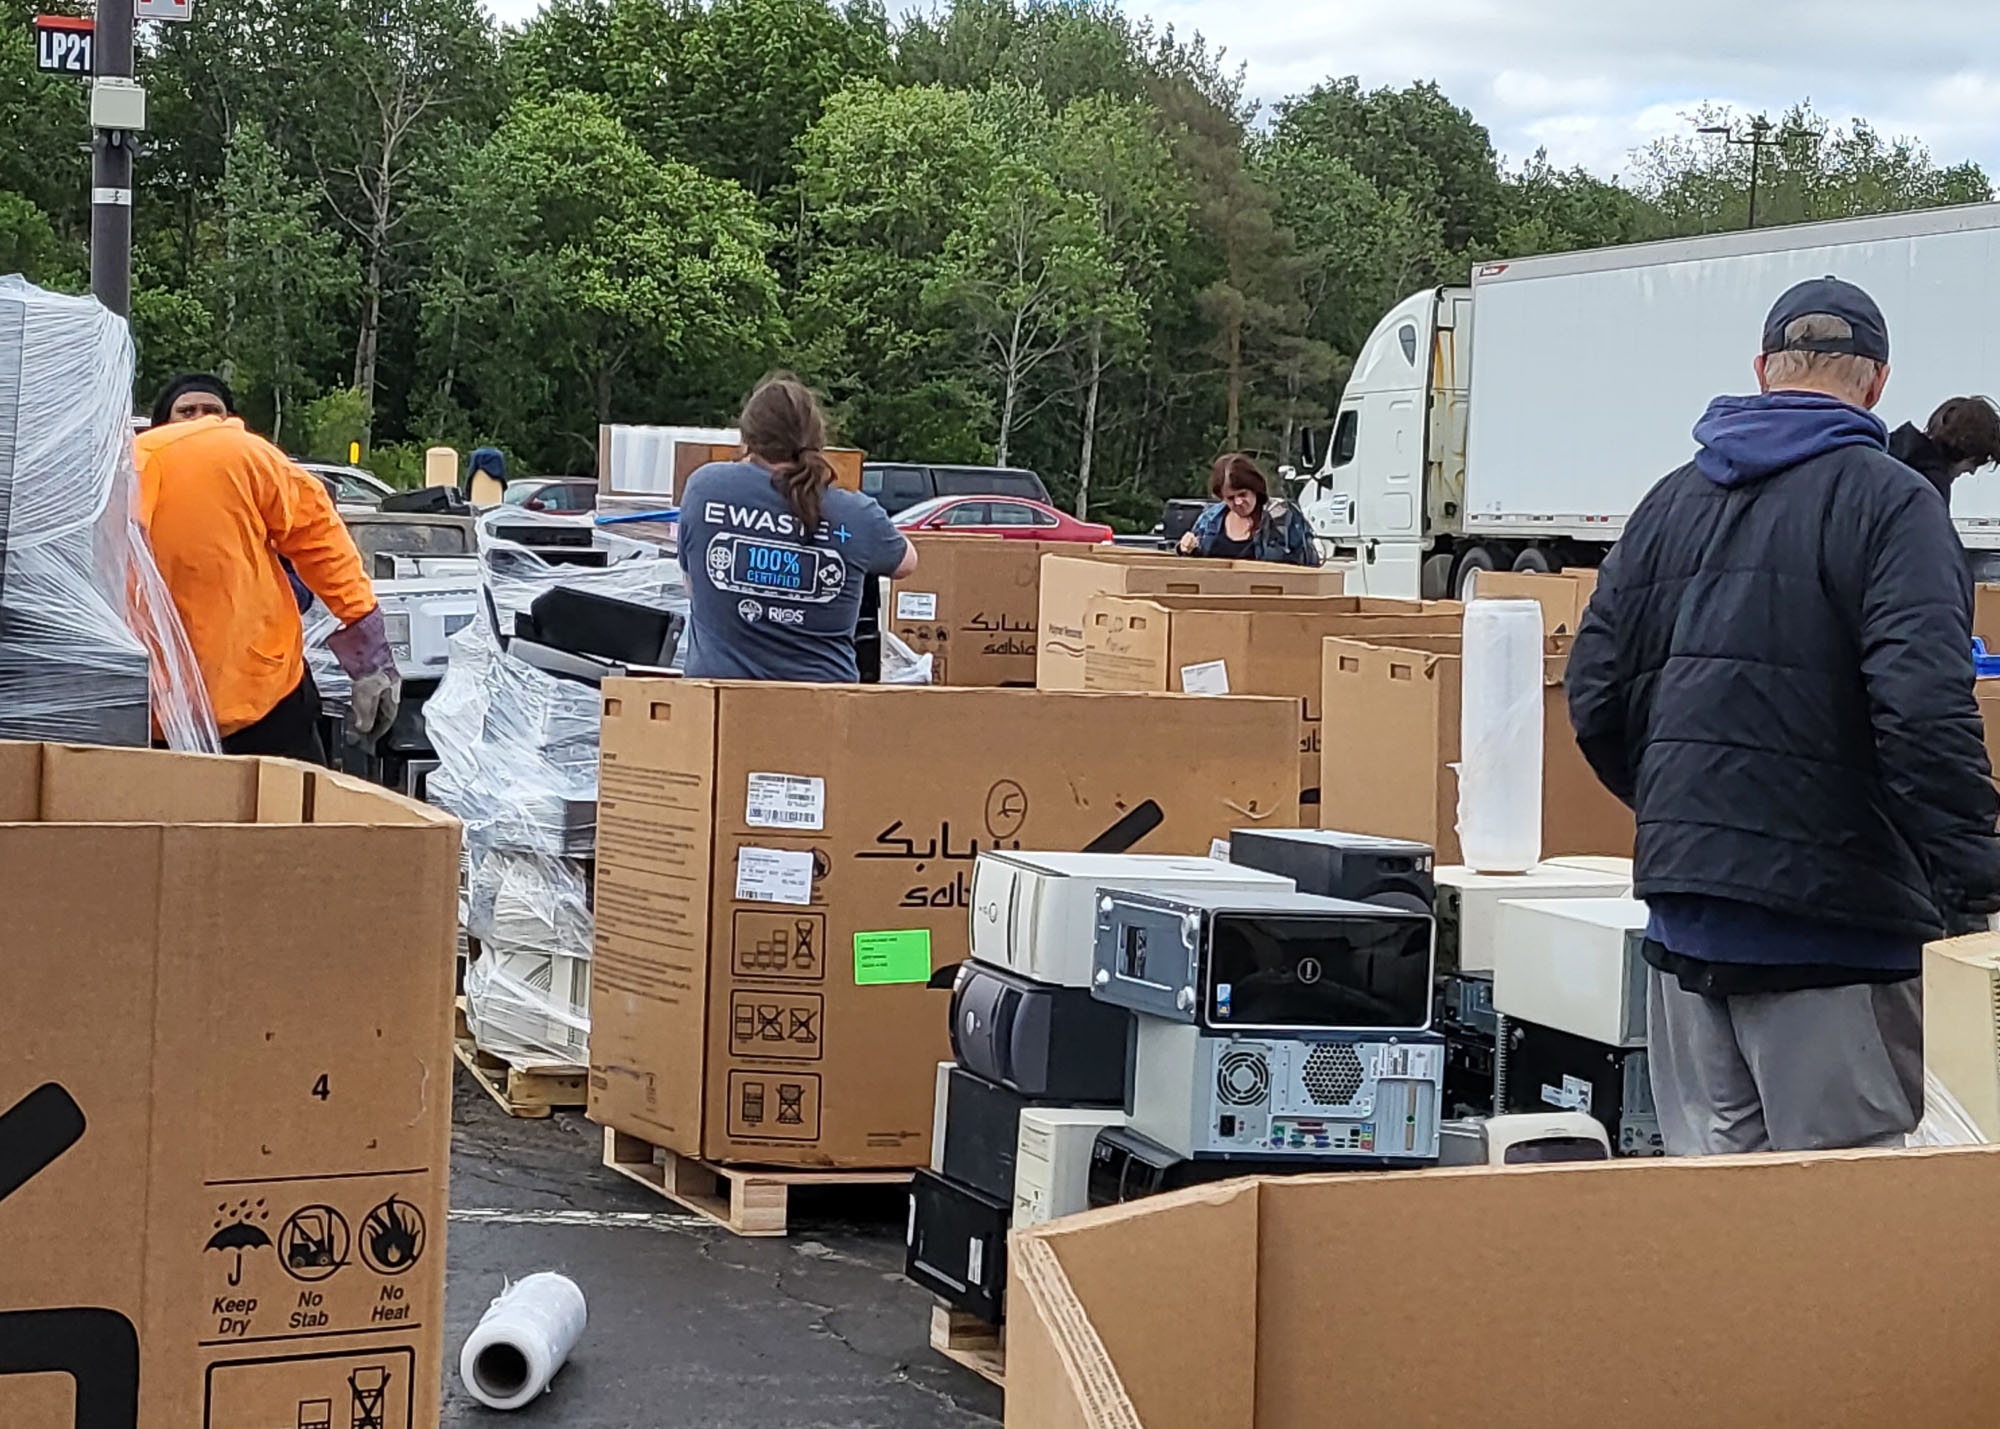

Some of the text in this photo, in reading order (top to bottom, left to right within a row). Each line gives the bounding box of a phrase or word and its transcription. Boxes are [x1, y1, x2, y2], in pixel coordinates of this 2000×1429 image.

[39, 31, 91, 71] LP21
[748, 546, 800, 575] 100%
[746, 569, 801, 589] CERTIFIED
[311, 1073, 331, 1101] 4
[298, 1290, 323, 1308] No
[380, 1284, 404, 1301] No
[212, 1296, 258, 1315] Keep
[371, 1303, 411, 1322] Heat
[218, 1316, 251, 1337] Dry
[288, 1310, 329, 1329] Stab
